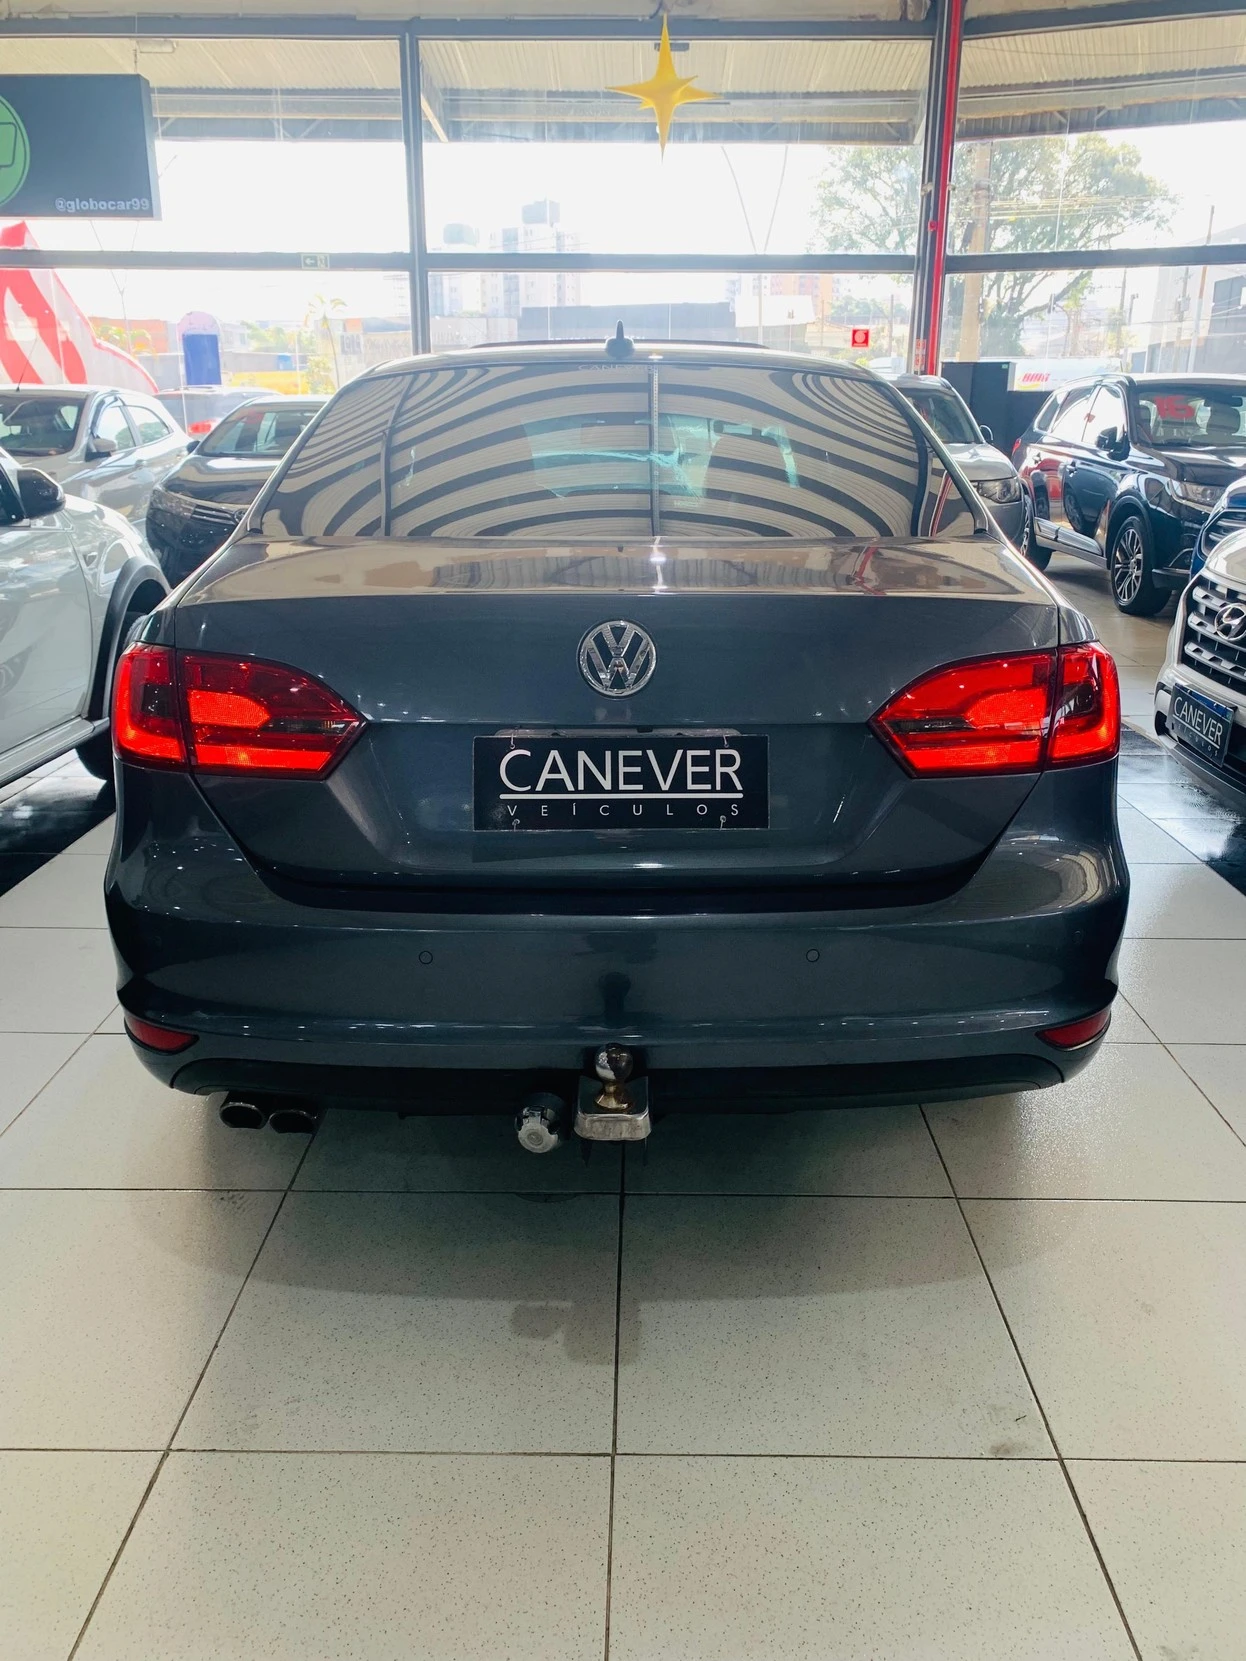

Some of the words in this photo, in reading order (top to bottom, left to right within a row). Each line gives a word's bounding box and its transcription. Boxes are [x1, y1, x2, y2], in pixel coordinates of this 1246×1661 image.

[55, 197, 150, 213] @globocar99
[1174, 696, 1223, 746] CANEVER
[499, 748, 744, 792] CANEVER
[507, 802, 739, 816] VEÍCULOS
